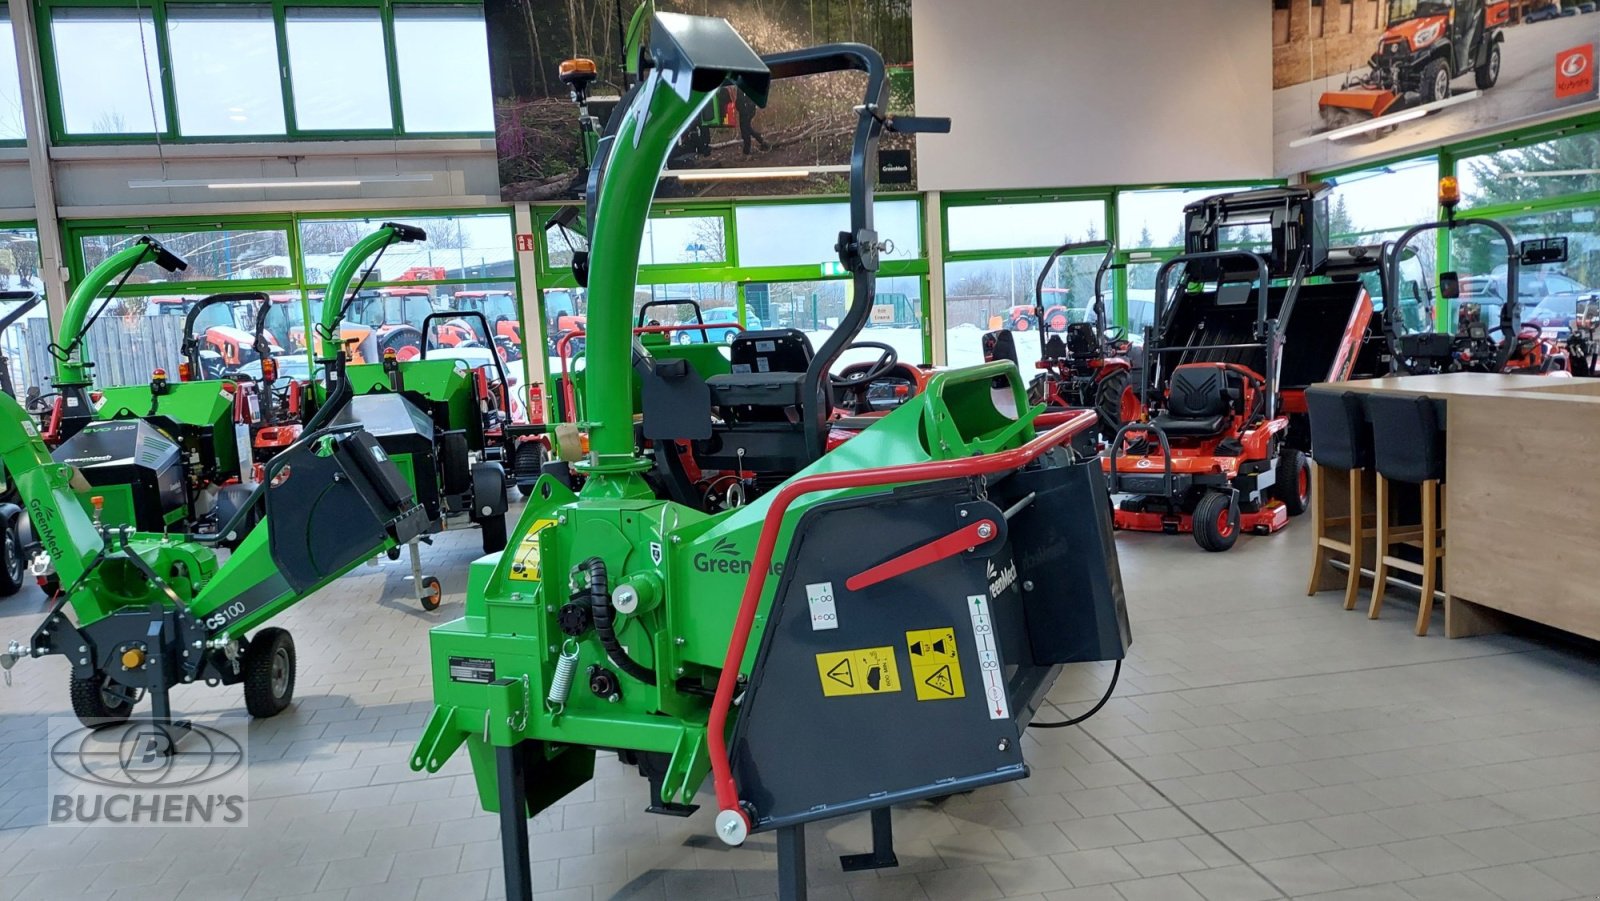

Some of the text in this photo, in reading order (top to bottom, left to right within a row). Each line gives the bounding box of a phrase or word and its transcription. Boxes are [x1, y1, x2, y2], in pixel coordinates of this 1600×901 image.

[113, 424, 137, 432] 165
[31, 498, 64, 560] GreenMech
[206, 601, 246, 630] CS100
